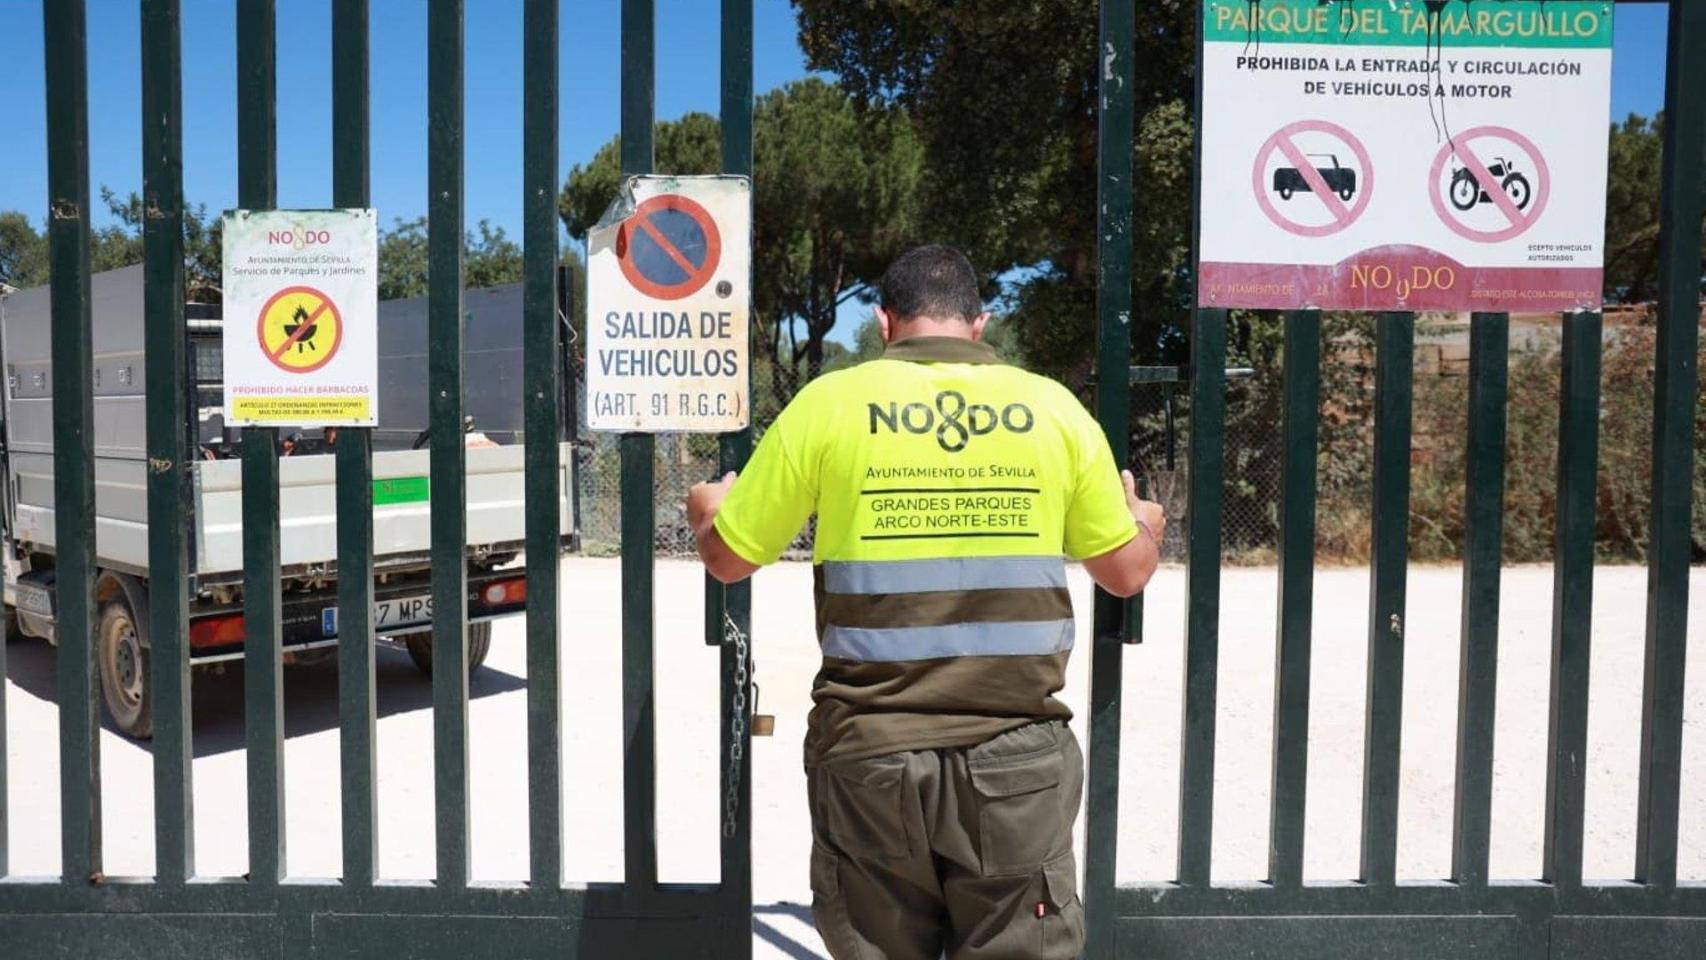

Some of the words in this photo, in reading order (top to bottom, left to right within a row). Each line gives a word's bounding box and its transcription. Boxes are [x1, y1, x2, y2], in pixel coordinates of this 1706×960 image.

[1215, 6, 1328, 35] PARQUE
[1339, 7, 1389, 34] DEL
[1398, 9, 1599, 37] TAMARGUILLO
[1236, 56, 1330, 72] PROHIBIDA
[1335, 58, 1356, 72] LA
[1362, 58, 1440, 73] ENTRADA
[1447, 60, 1458, 73] Y
[1464, 59, 1582, 75] CIRCULACIÓN
[1304, 81, 1326, 95] DE
[1332, 79, 1430, 97] VEHÍCULOS
[1434, 84, 1446, 97] A
[1451, 84, 1513, 98] MOTOR
[1527, 254, 1574, 262] AUTORIZADOS
[233, 266, 268, 276] Servicio
[270, 266, 281, 275] de
[284, 266, 320, 277] Parques
[322, 268, 329, 277] y
[329, 266, 366, 276] Jardines
[605, 311, 692, 339] SALIDA
[700, 312, 732, 339] DE
[599, 349, 738, 377] VEHICULOS
[232, 385, 284, 394] PROHIBIDO
[285, 385, 316, 394] HACER
[317, 385, 369, 394] BARBACOAS
[594, 391, 641, 418] (ART.
[651, 393, 669, 417] 91
[866, 466, 965, 479] AYUNTAMIENTO
[968, 466, 985, 478] DE
[988, 464, 1037, 478] SEVILLA
[871, 497, 950, 512] GRANDES
[955, 496, 1032, 511] PARQUES
[874, 515, 922, 529] ARCO
[926, 514, 1028, 528] NORTE-ESTE
